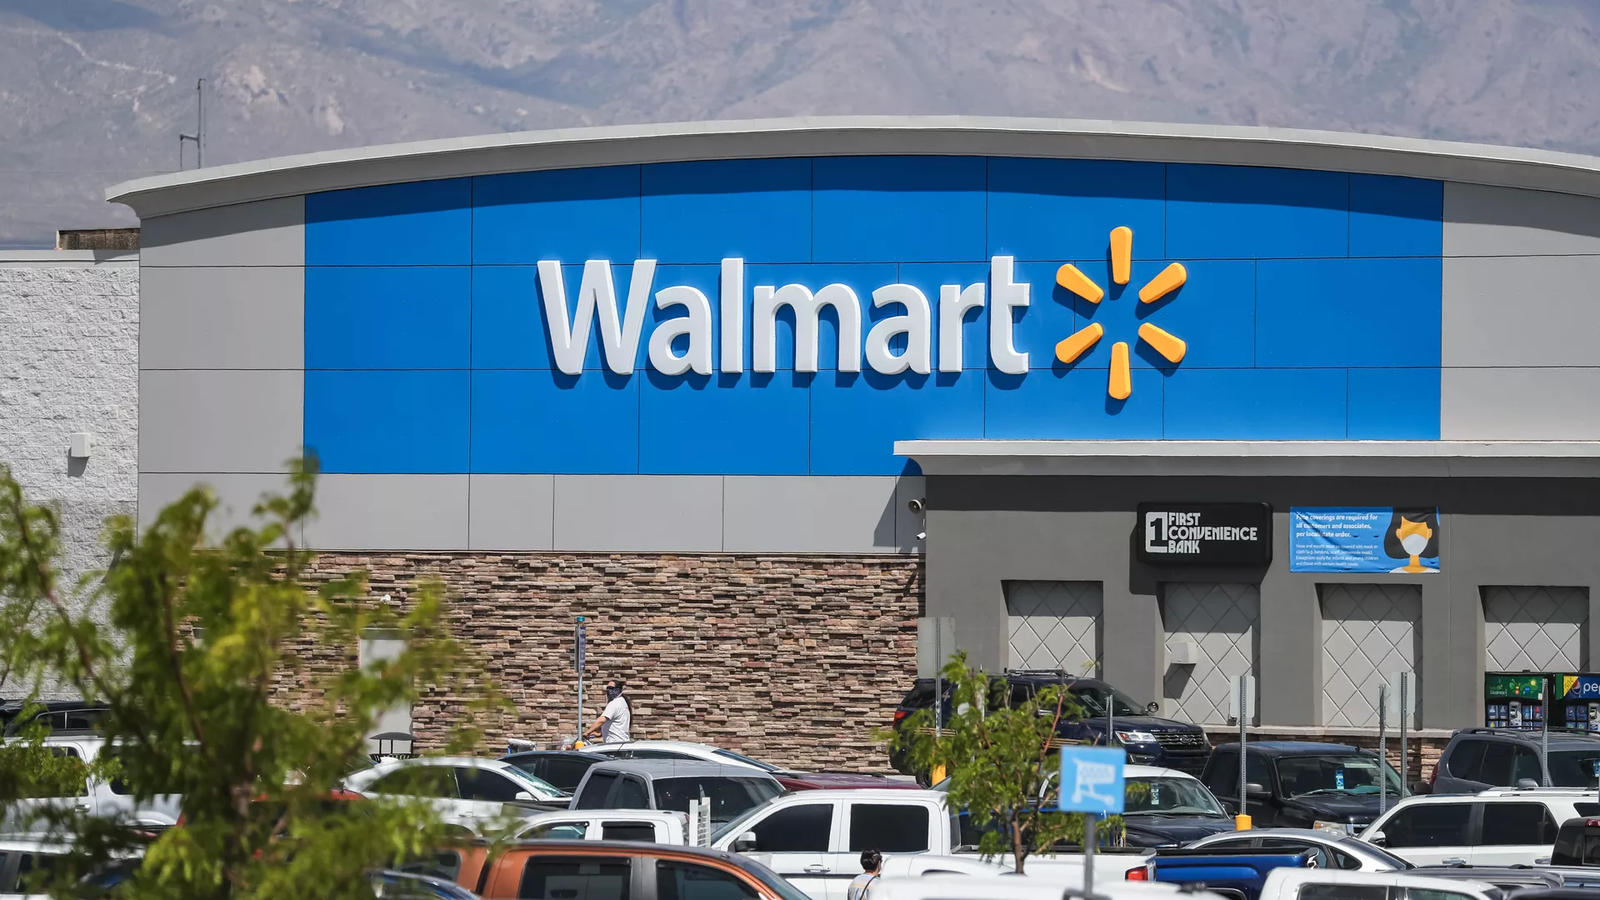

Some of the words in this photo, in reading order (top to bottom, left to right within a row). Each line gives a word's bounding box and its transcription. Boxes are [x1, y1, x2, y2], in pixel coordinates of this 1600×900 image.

[537, 255, 1030, 375] Walmart
[1168, 512, 1201, 526] FIRST
[1310, 514, 1335, 522] coverings
[1346, 514, 1369, 522] required
[1168, 526, 1258, 541] CONVENIENCE
[1168, 540, 1200, 554] BANK
[1583, 682, 1600, 695] pe
